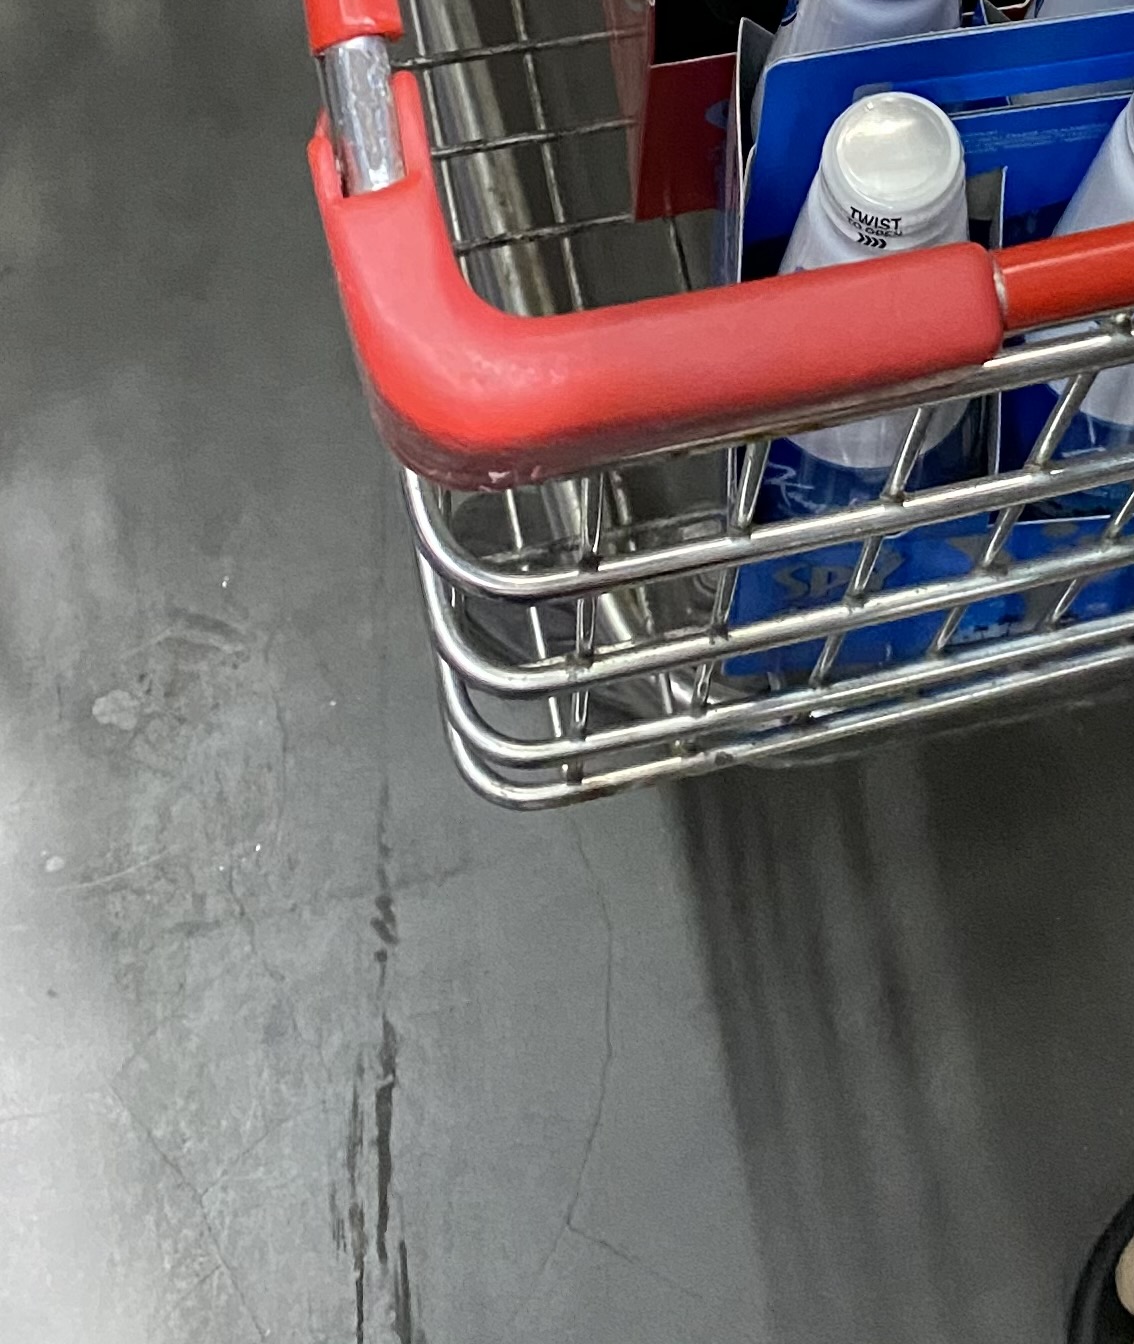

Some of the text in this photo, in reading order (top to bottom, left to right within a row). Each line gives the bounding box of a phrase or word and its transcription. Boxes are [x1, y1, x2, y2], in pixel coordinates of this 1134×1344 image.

[847, 217, 903, 238] TO OPEN
[850, 205, 902, 231] TWIST
